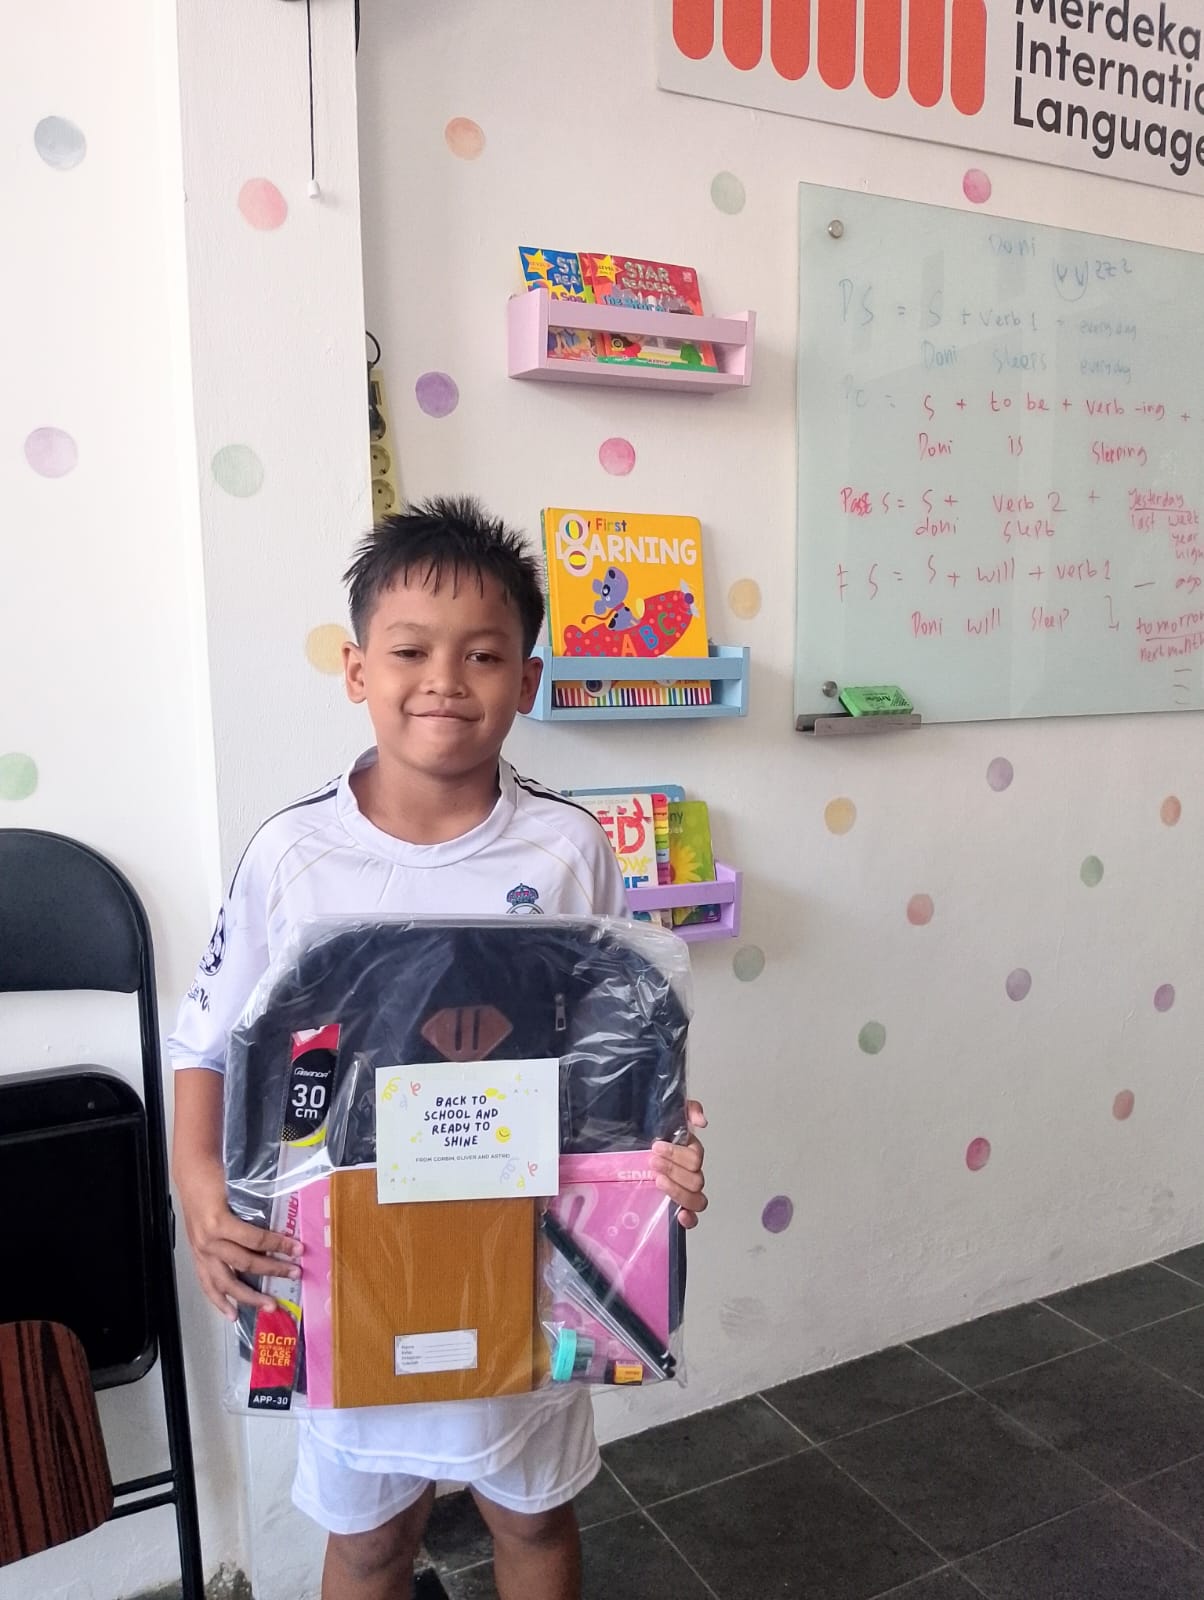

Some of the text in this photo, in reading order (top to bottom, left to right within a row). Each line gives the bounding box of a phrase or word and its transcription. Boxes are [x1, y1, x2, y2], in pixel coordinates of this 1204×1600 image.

[556, 256, 580, 275] ST
[624, 261, 670, 283] STAR
[622, 277, 677, 295] READERS
[991, 390, 1012, 412] to
[1027, 392, 1049, 412] be
[919, 432, 953, 461] Doni
[1048, 491, 1068, 513] 2
[595, 517, 628, 532] First
[915, 517, 959, 536] doni
[555, 531, 697, 566] LARNING
[976, 556, 1016, 584] will
[639, 625, 659, 649] B
[657, 612, 676, 637] C
[911, 610, 943, 639] Doni
[967, 608, 1000, 635] will
[291, 1083, 326, 1109] 30
[435, 1095, 487, 1107] BACK TO
[295, 1108, 318, 1119] cm
[424, 1108, 499, 1121] SCHOOL AND
[431, 1121, 490, 1135] READY TO
[444, 1136, 479, 1148] SHINE
[258, 1331, 296, 1346] 30cm
[258, 1356, 290, 1367] RULER
[259, 1349, 291, 1359] GLASS
[252, 1394, 288, 1405] APP-30
